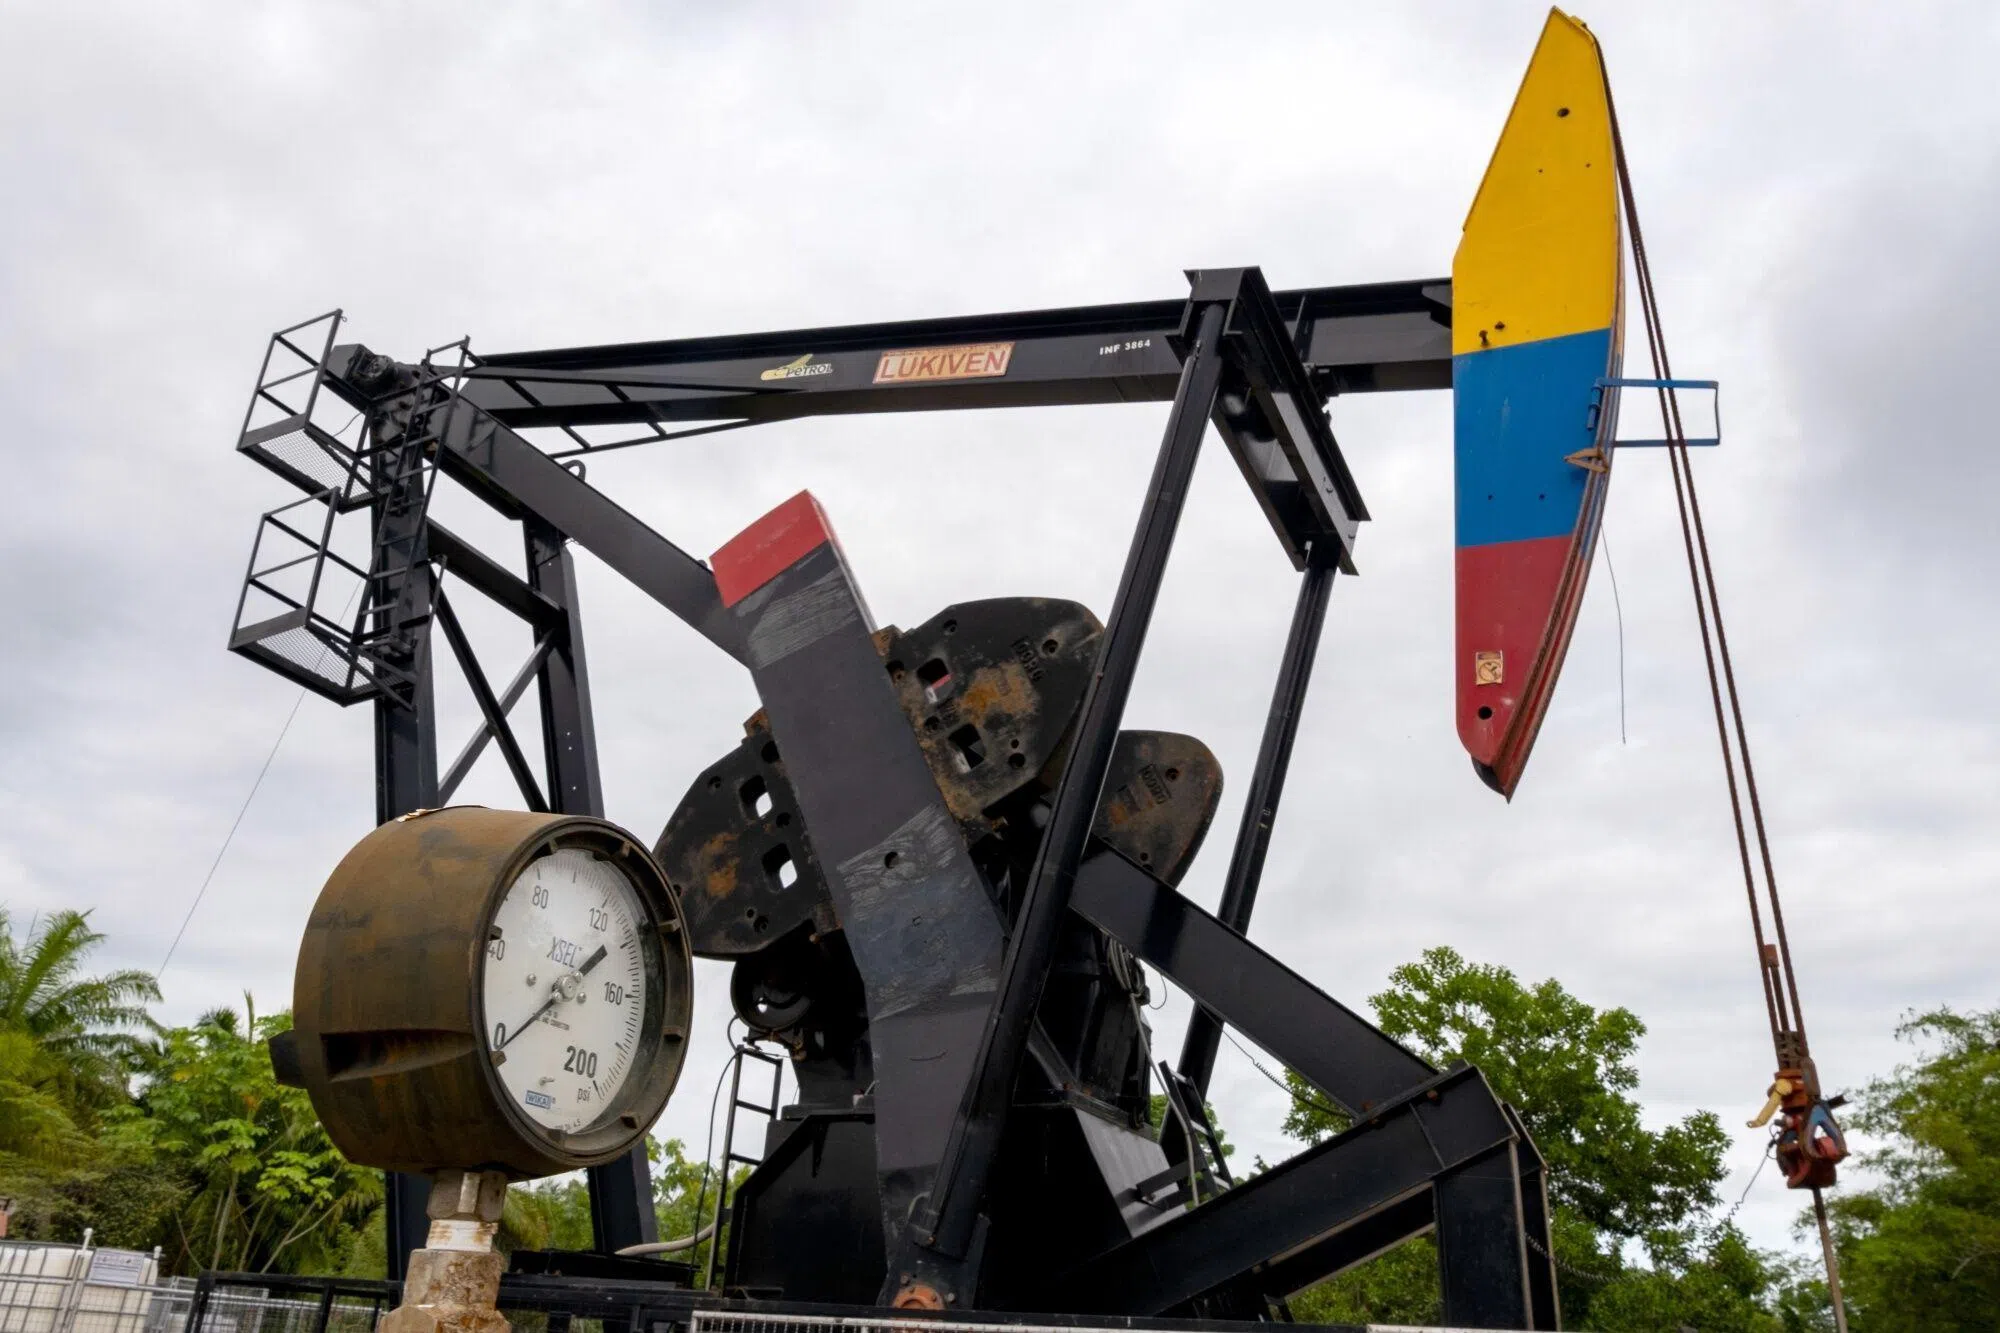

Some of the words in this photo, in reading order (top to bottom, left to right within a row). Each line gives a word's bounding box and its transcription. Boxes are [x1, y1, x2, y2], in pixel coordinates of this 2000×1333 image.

[1099, 343, 1120, 355] INF
[1124, 339, 1150, 351] 3864
[879, 350, 1005, 379] LUKIVEN
[532, 885, 549, 909] 80
[588, 907, 608, 932] 120
[604, 981, 623, 1006] 160
[493, 1022, 507, 1050] 0
[563, 1045, 598, 1079] 200
[527, 1092, 548, 1106] WIKA
[576, 1087, 592, 1103] psi
